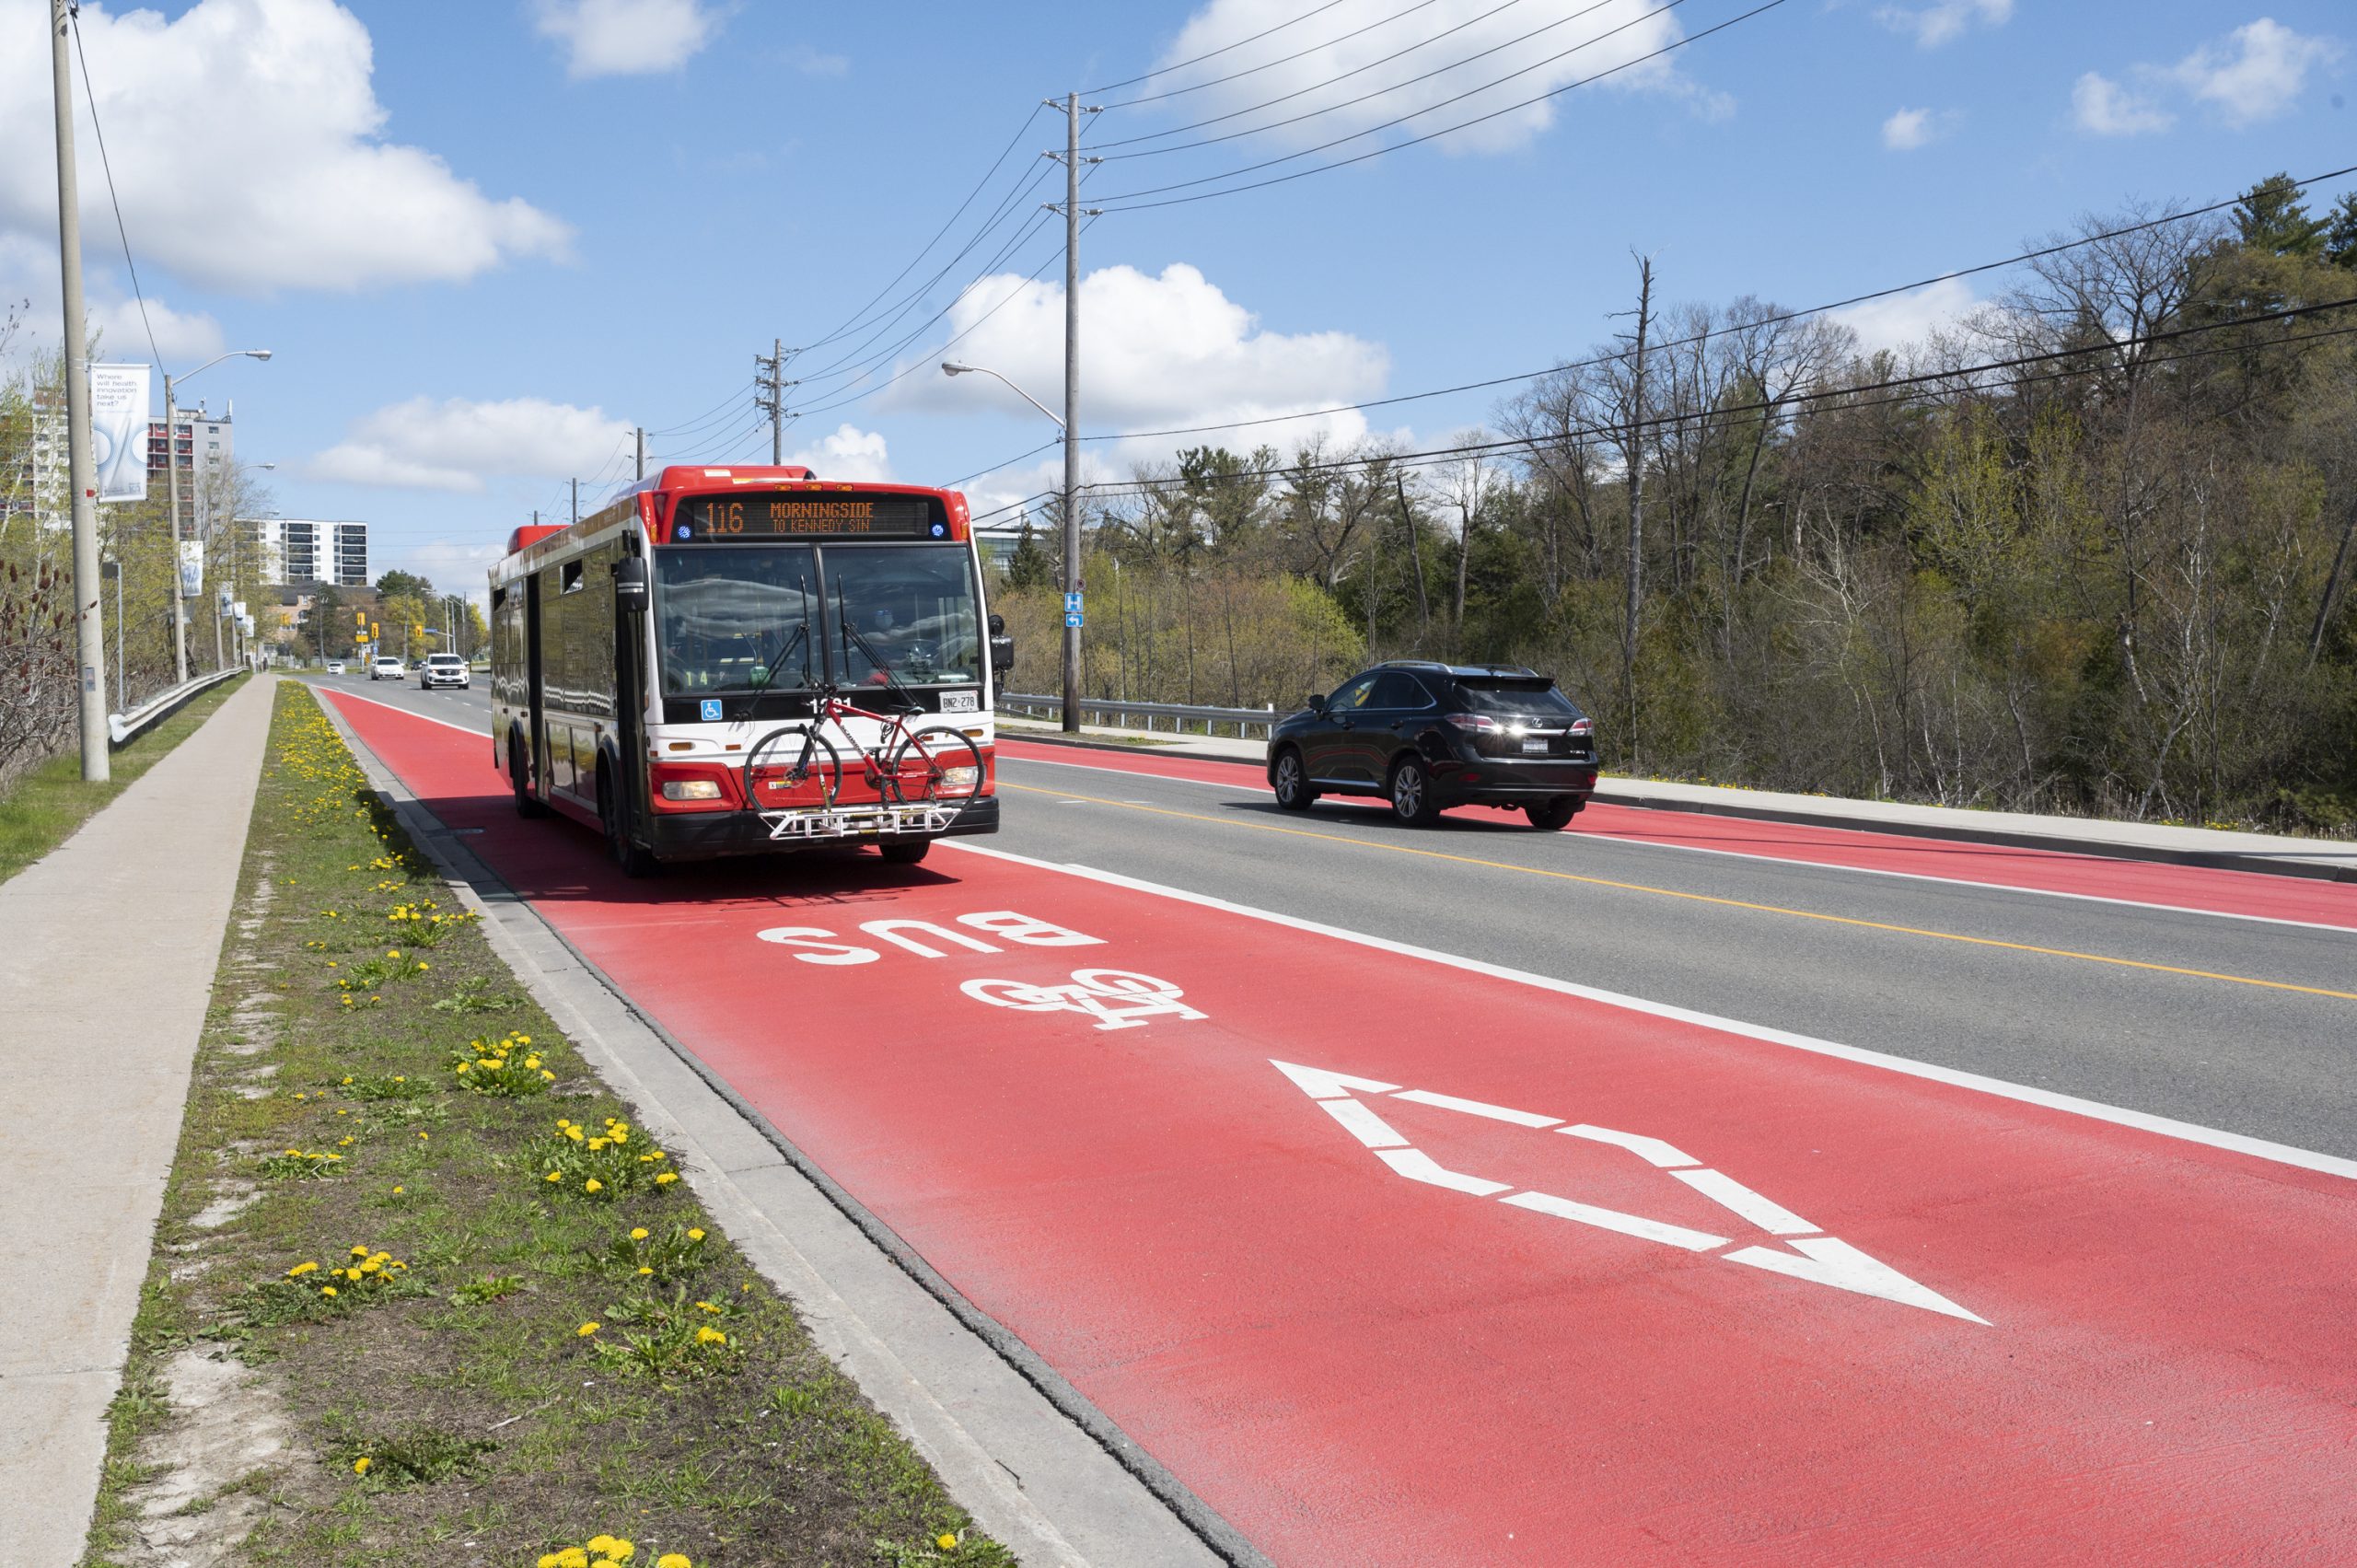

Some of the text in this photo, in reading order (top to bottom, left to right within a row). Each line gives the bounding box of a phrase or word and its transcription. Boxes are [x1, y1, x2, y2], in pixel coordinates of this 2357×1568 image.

[706, 502, 744, 533] 116
[770, 502, 874, 518] MORNINGSIDE
[773, 518, 870, 532] TO KENNEDY STN
[1067, 595, 1081, 610] H
[756, 911, 1109, 965] BUS
